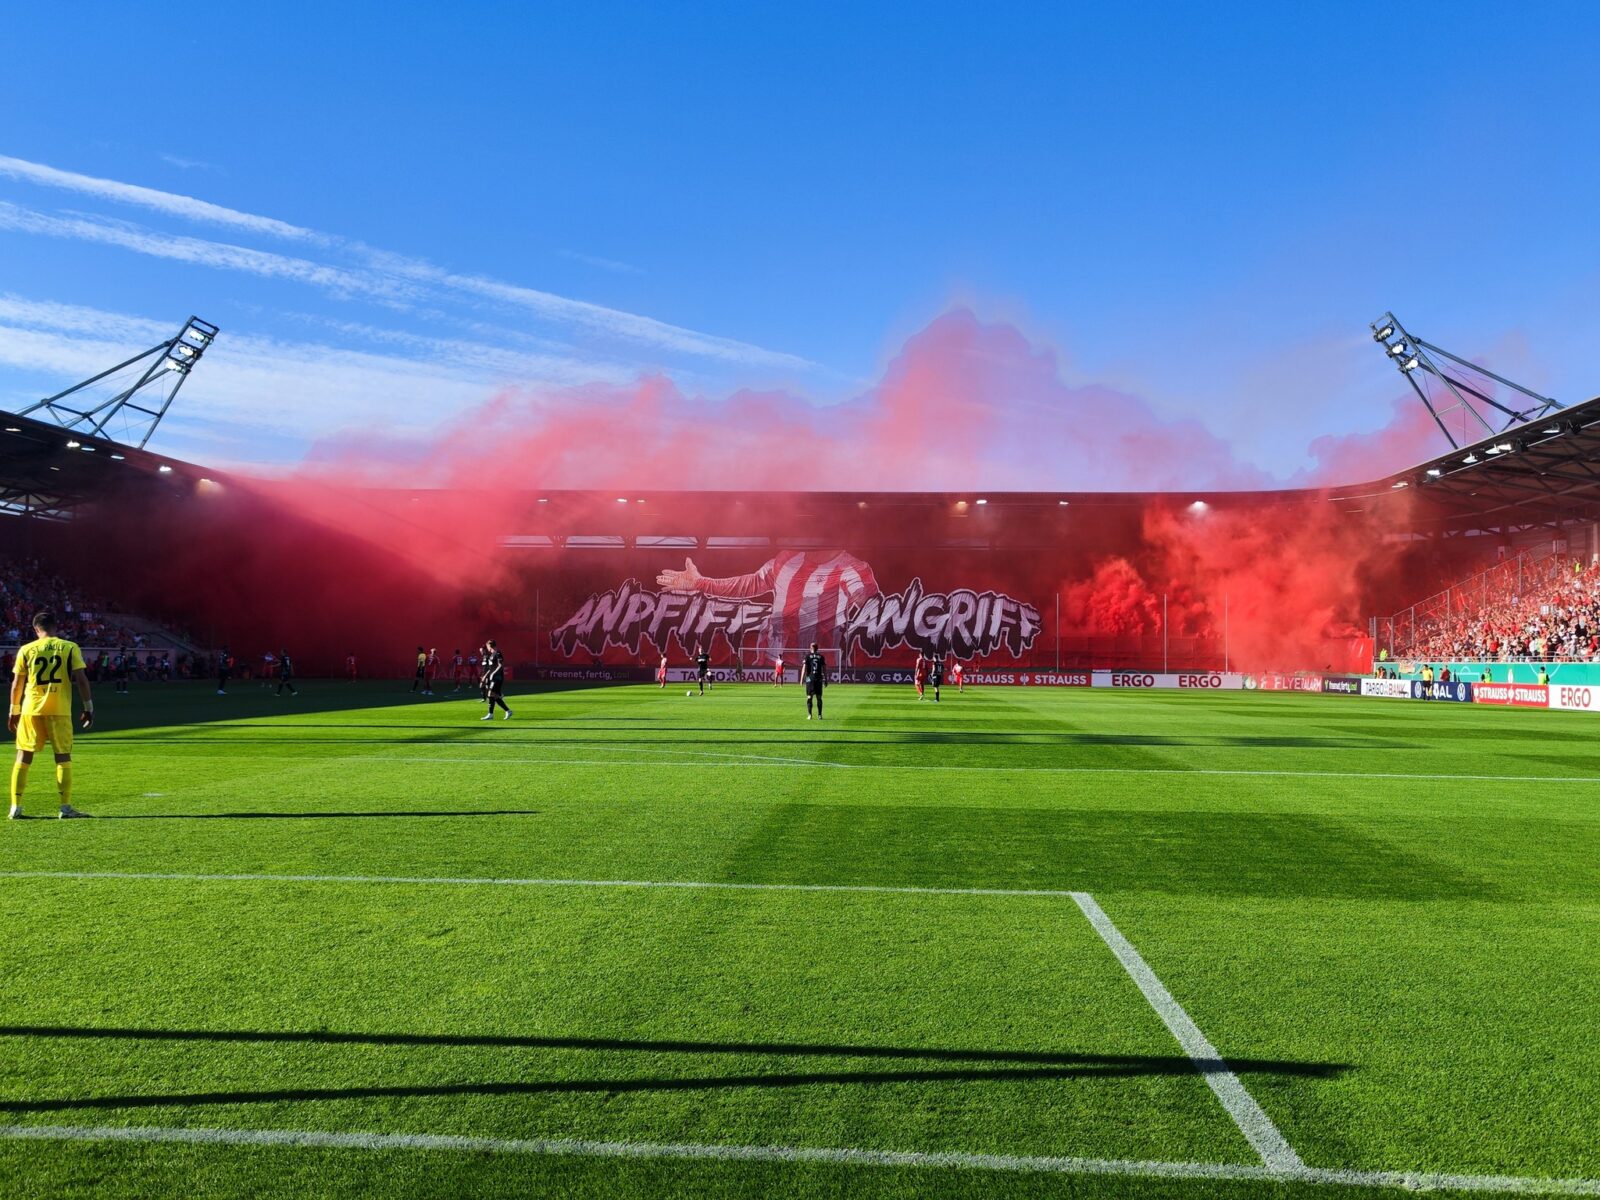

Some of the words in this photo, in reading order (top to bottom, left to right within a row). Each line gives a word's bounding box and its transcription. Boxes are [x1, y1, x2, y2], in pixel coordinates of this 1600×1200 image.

[552, 580, 773, 645] ANPFIFF
[847, 578, 1042, 650] ANGRIFF
[34, 655, 61, 685] 22
[812, 658, 818, 670] 5
[963, 674, 1015, 684] STRAUSS
[1034, 674, 1087, 684] STRAUSS
[1111, 674, 1155, 687] ERGO
[1178, 674, 1222, 688] ERGO
[1479, 686, 1508, 700] STRAUSS
[1515, 687, 1547, 703] STRAUSS
[1560, 687, 1592, 708] ERGO
